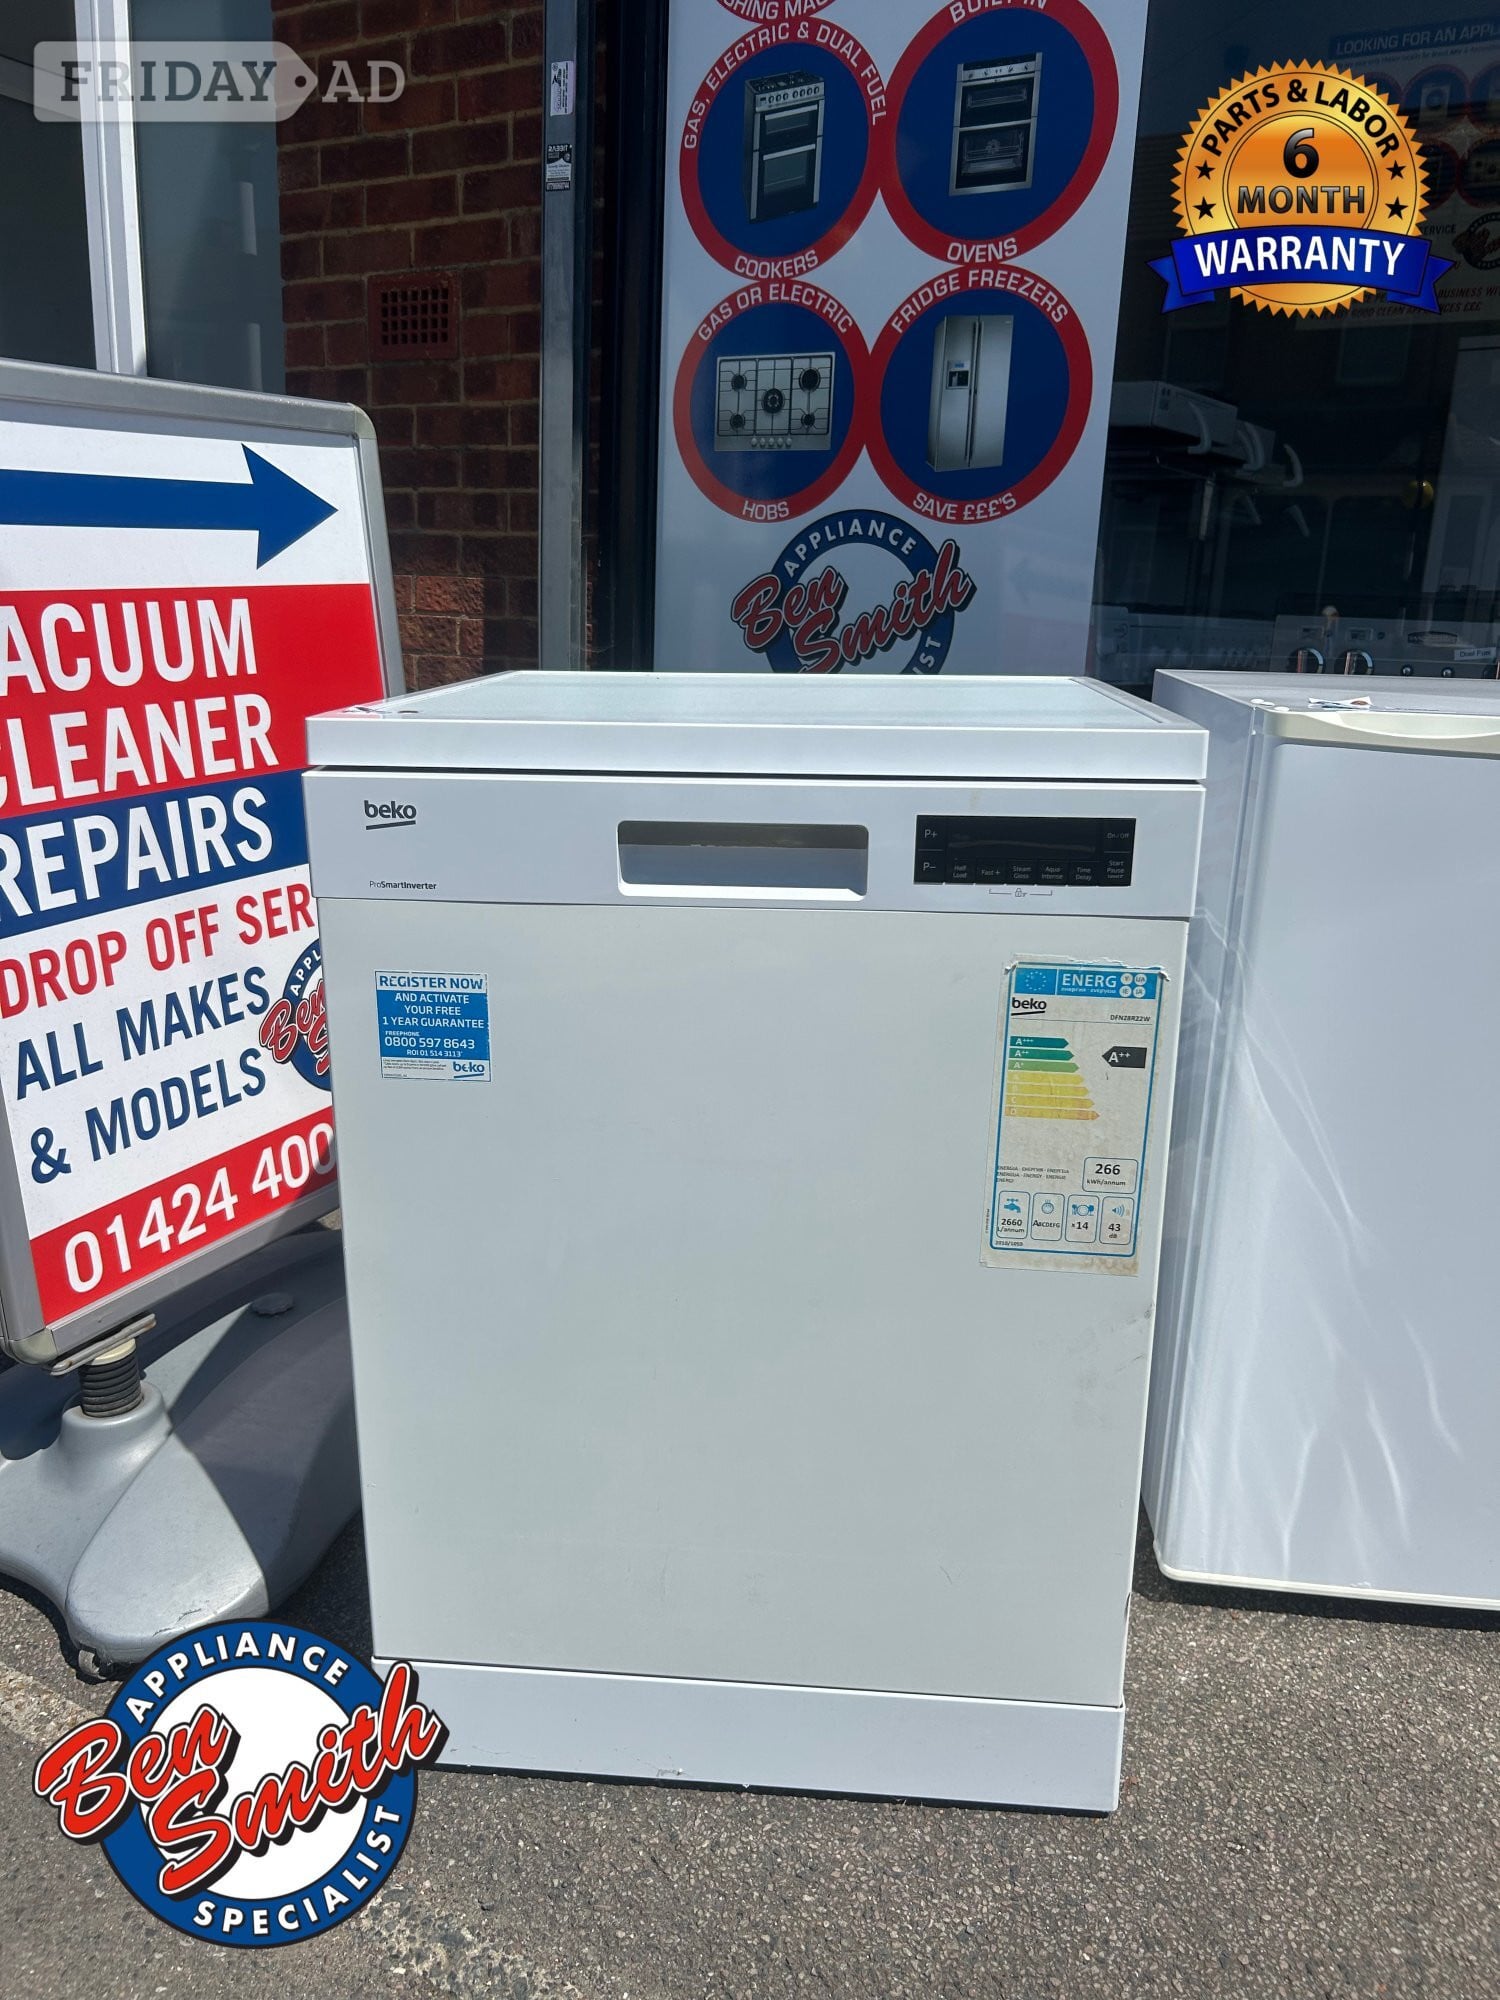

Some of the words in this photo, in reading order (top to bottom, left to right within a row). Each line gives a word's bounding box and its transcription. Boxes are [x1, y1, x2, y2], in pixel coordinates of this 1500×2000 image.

[1336, 35, 1399, 56] LOOKING
[1402, 31, 1430, 47] FOR
[1433, 27, 1456, 43] AN
[684, 97, 711, 150] GAS,
[706, 22, 790, 90] ELECTRIC
[797, 22, 810, 39] &
[817, 24, 863, 68] DUAL
[861, 65, 888, 126] FUEL
[947, 238, 1018, 263] OVENS
[734, 250, 819, 280] COOKERS
[890, 275, 961, 334] FRIDGE
[968, 269, 1069, 325] FREEZERS
[699, 303, 733, 341] GAS
[736, 287, 763, 309] OR
[769, 284, 854, 335] ELECTRIC
[742, 500, 790, 520] HOBS
[913, 493, 958, 520] SAVE
[783, 518, 917, 578] APPLIANCE
[731, 566, 848, 649] Ben
[793, 539, 976, 674] Smith
[0, 693, 279, 808] LEANER
[364, 800, 417, 820] beko
[924, 829, 938, 839] P+
[369, 880, 437, 890] ProSmartInverter
[0, 930, 128, 1018] DROP
[145, 903, 219, 972] OFF
[379, 975, 447, 989] REGISTER
[450, 977, 484, 990] NOW
[1062, 973, 1117, 988] ENERG
[395, 992, 418, 1002] AND
[420, 993, 470, 1004] ACTIVATE
[1011, 997, 1047, 1010] beko
[404, 1005, 433, 1015] YOUR
[435, 1006, 462, 1016] FREE
[382, 1016, 389, 1025] 1
[391, 1017, 418, 1026] YEAR
[420, 1018, 485, 1028] GUARANTEE
[16, 1022, 104, 1100] ALL
[117, 966, 271, 1061] MAKES
[1015, 1037, 1034, 1046] A+++
[384, 1036, 417, 1048] 0800
[418, 1037, 441, 1048] 597
[443, 1038, 475, 1049] 8643
[1014, 1049, 1029, 1057] A++
[1108, 1052, 1131, 1063] A++
[453, 1061, 485, 1073] beko
[30, 1127, 72, 1184] &
[85, 1047, 266, 1162] MODELS
[1095, 1163, 1121, 1175] 266
[1086, 1178, 1126, 1186] kWh/annum
[64, 1166, 239, 1294] 01424
[252, 1121, 336, 1199] 400
[1001, 1218, 1023, 1226] 2660
[1108, 1223, 1121, 1232] 43
